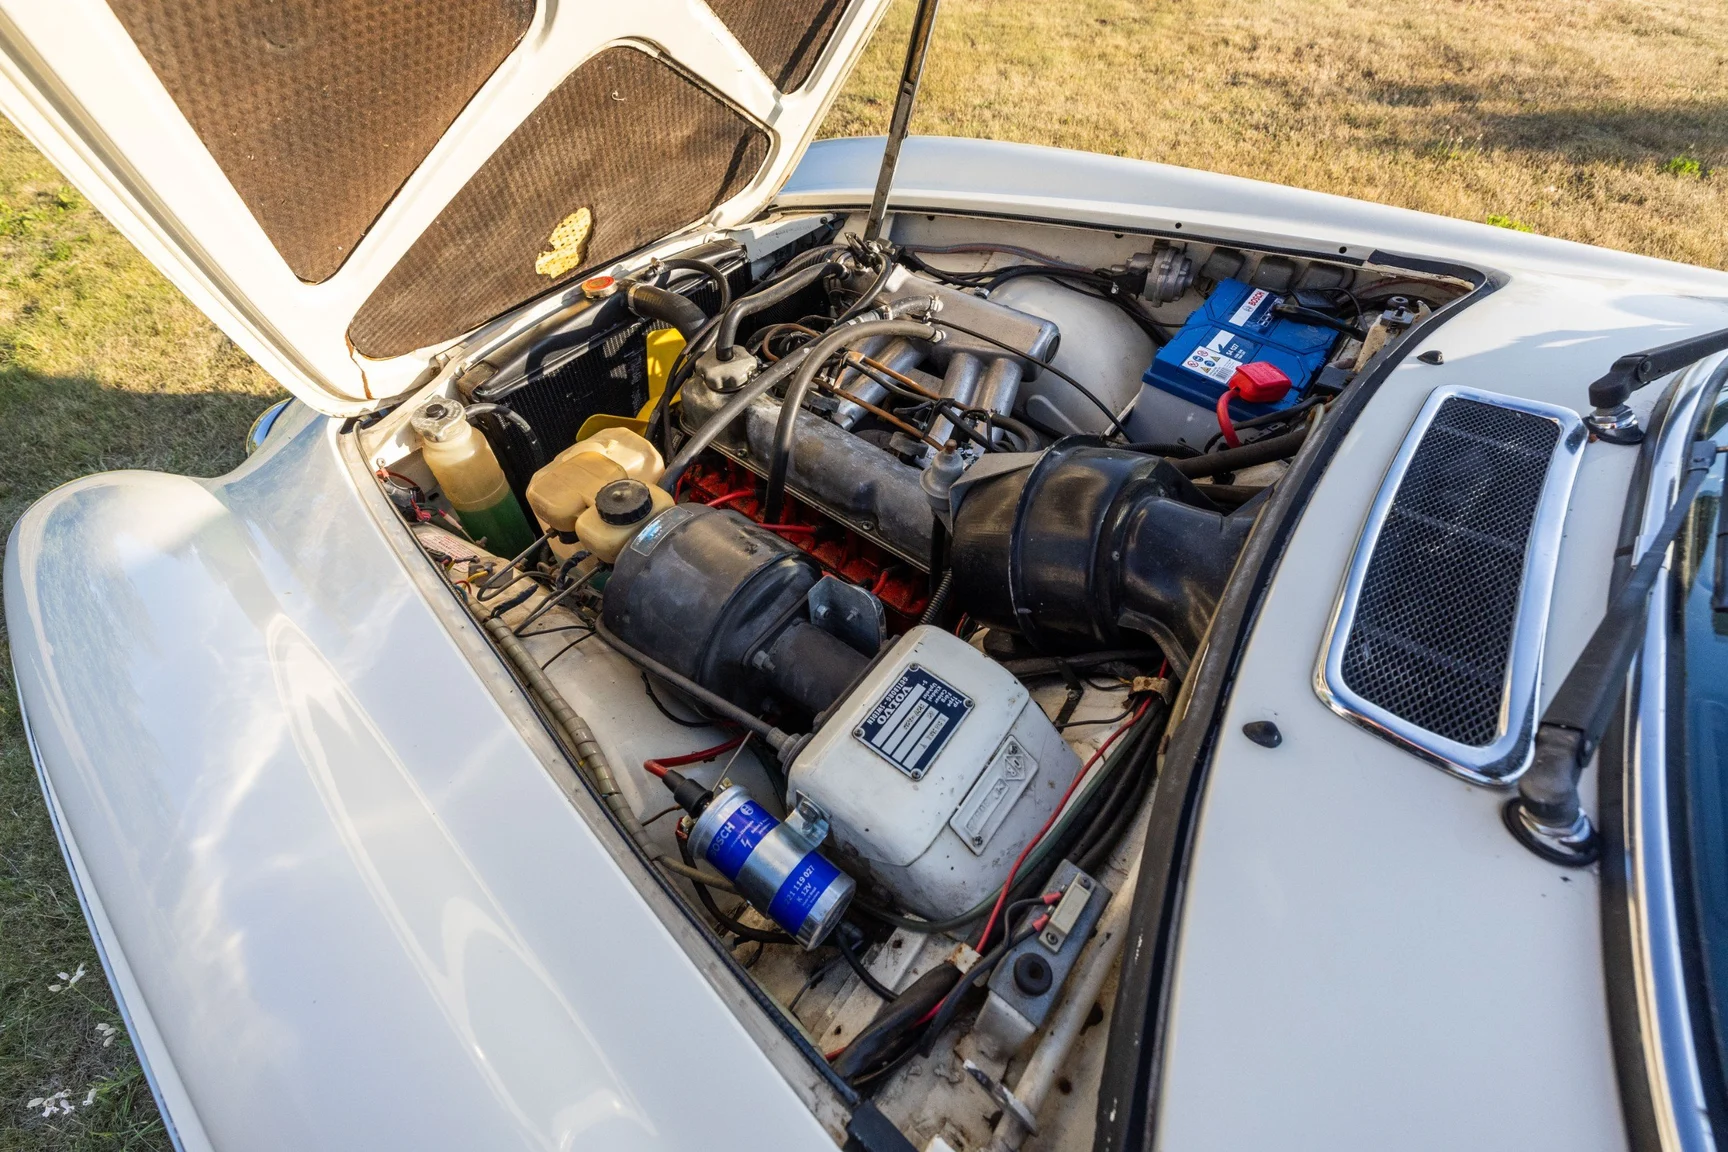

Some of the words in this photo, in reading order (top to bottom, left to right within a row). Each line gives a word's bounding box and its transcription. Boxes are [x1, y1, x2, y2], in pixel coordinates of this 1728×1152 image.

[1248, 291, 1264, 306] BOSCH
[868, 704, 885, 725] SWEDEN
[876, 685, 912, 726] VOLVO
[711, 821, 736, 856] BOSCH
[793, 876, 806, 890] 119
[804, 865, 815, 877] 027
[801, 882, 812, 896] 12V
